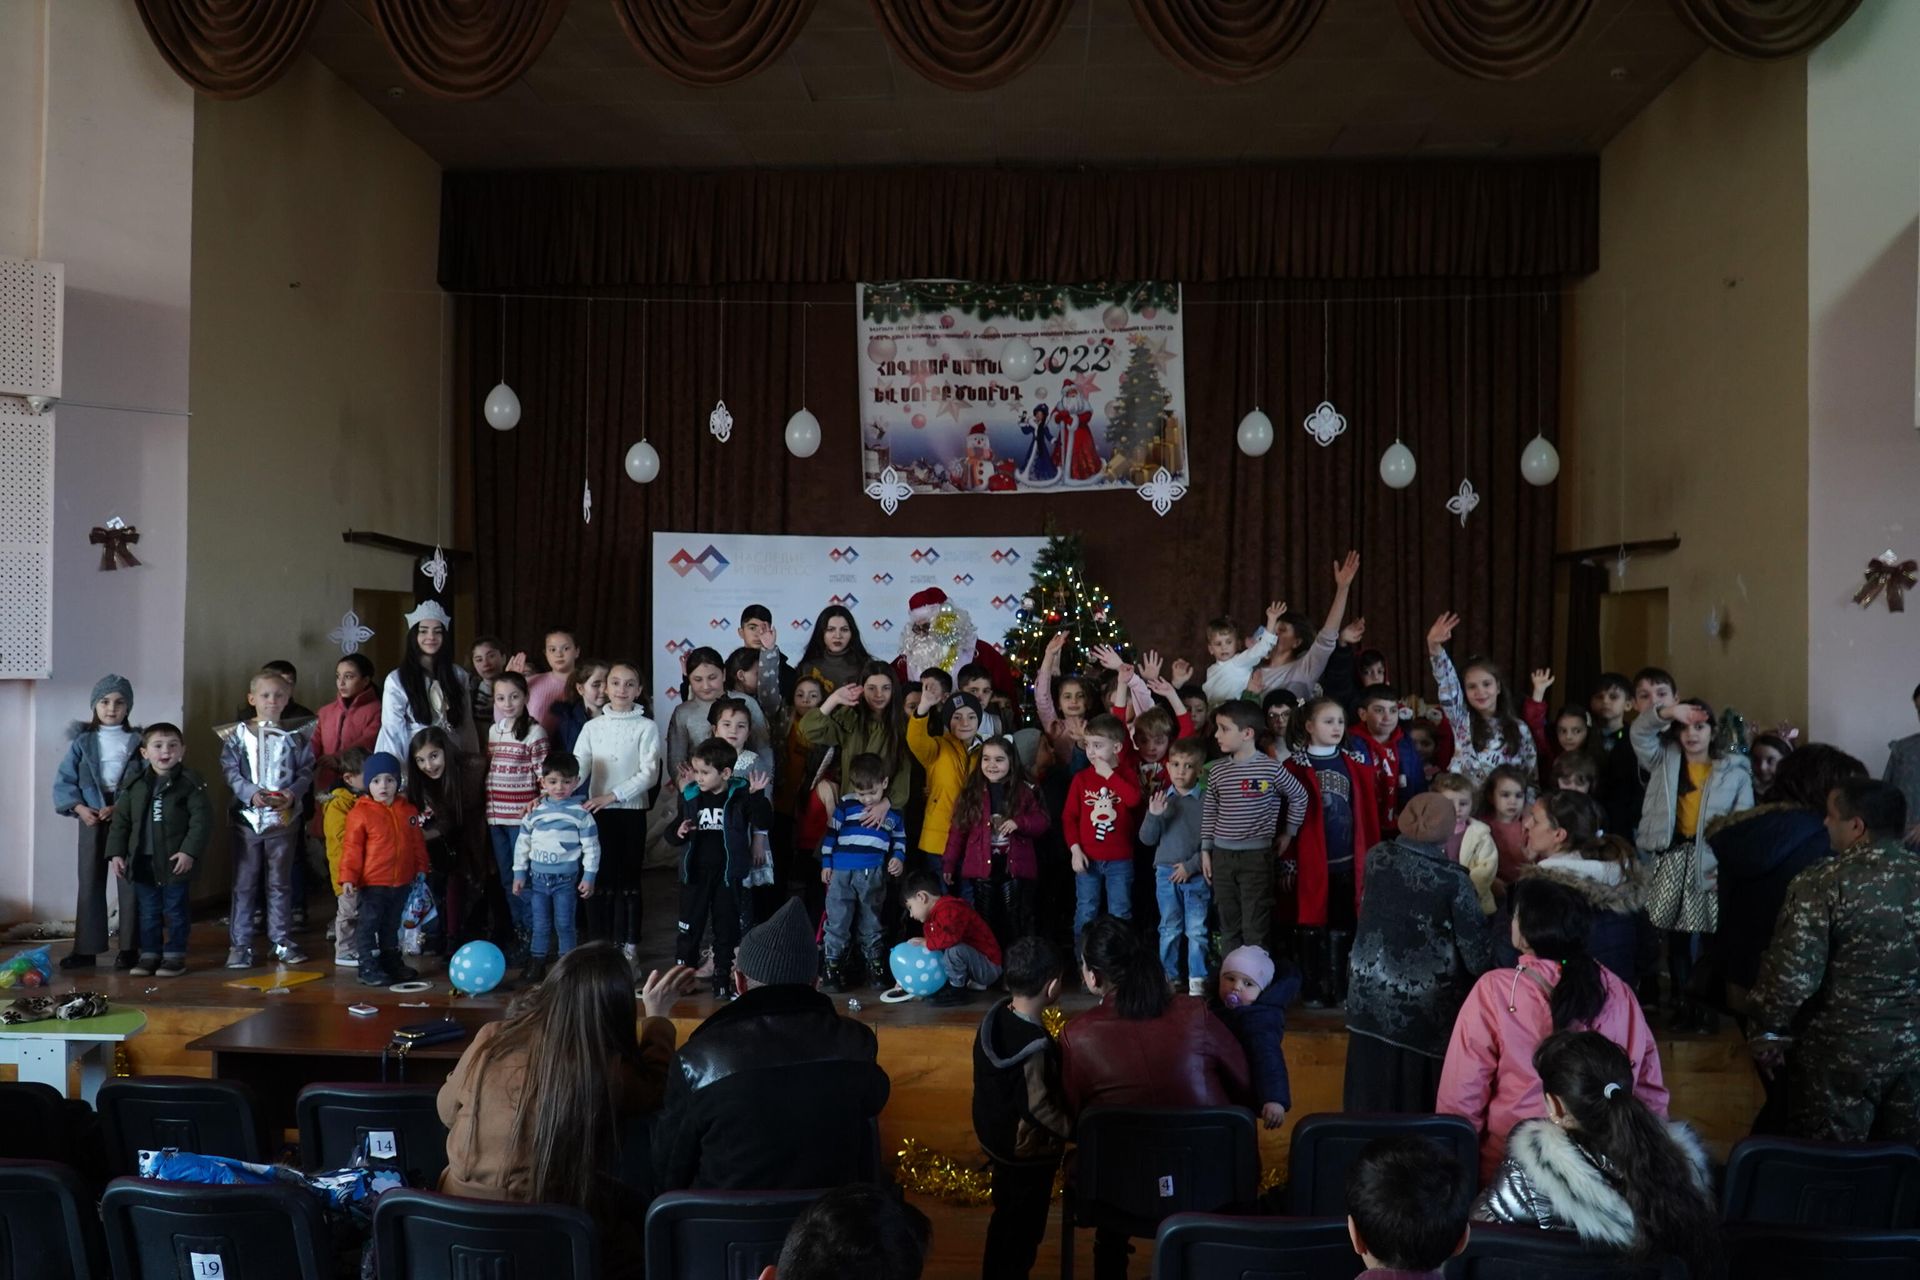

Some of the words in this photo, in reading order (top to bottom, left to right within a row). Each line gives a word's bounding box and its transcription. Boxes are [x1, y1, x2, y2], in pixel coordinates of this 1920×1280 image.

[952, 358, 1003, 376] ԱՄԱՆ
[1033, 345, 1111, 375] 2022
[376, 1139, 393, 1151] 14
[199, 1261, 220, 1276] 19
